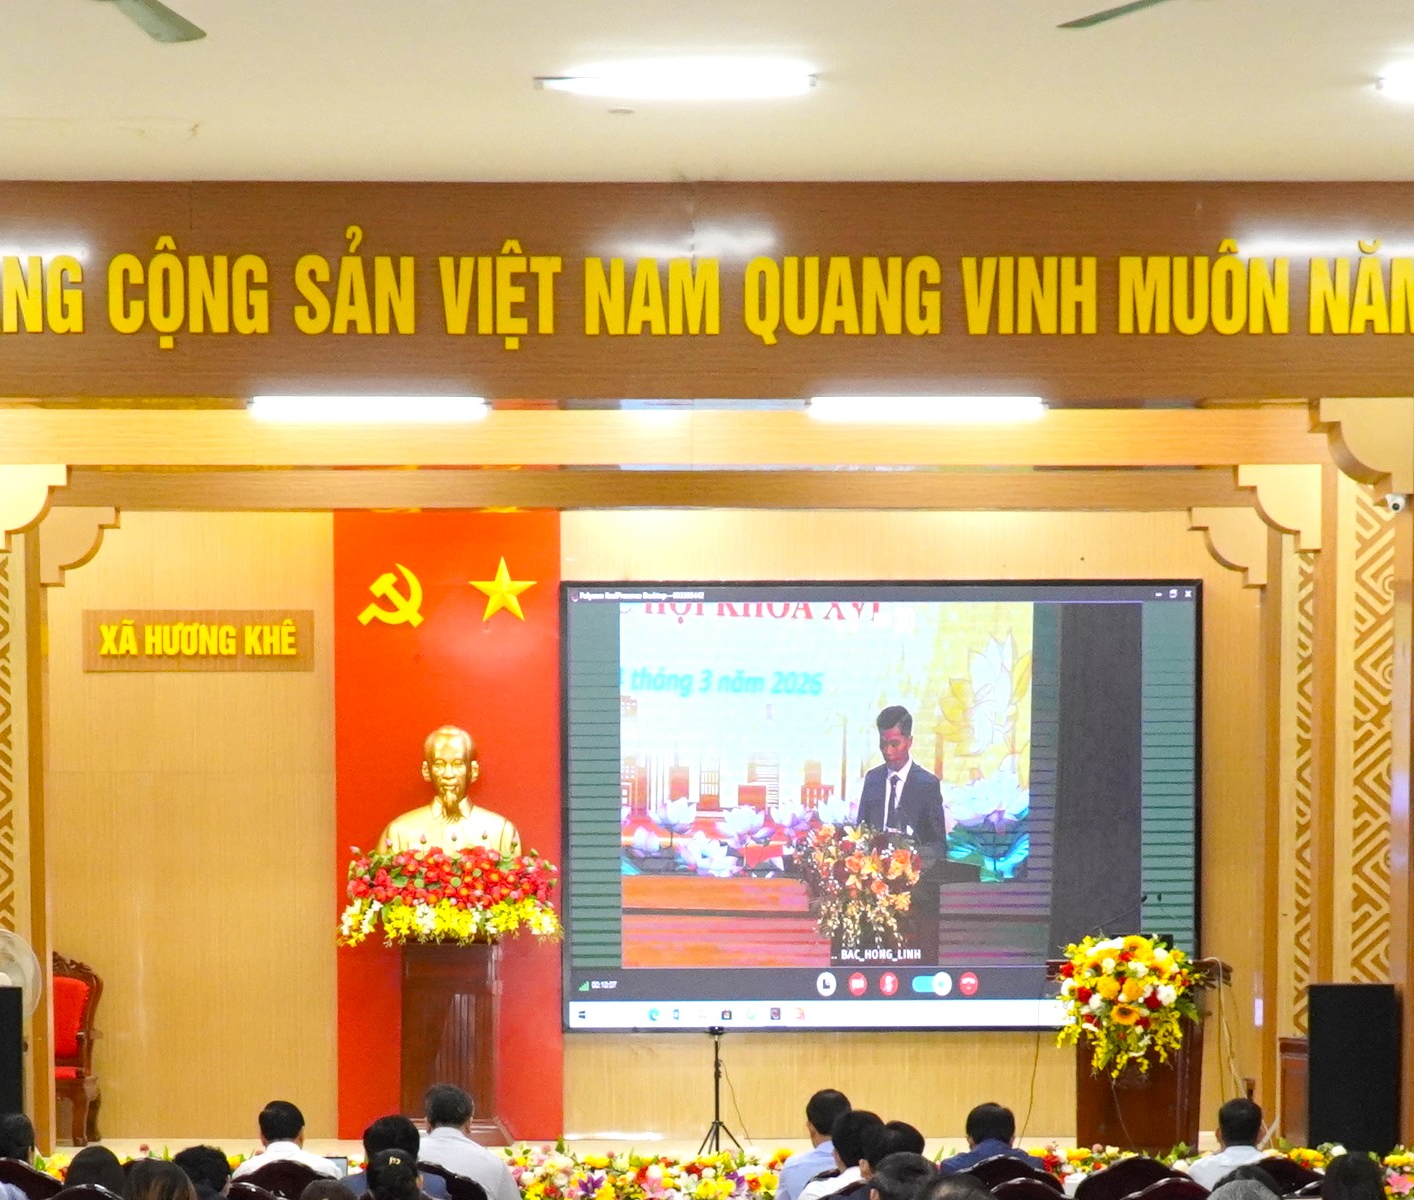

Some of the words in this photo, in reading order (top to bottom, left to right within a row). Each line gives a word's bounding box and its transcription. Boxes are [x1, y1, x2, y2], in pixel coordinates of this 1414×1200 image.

[108, 236, 269, 349] CỘNG
[293, 226, 415, 335] SẢN
[439, 239, 562, 349] VIỆT
[585, 257, 721, 335] NAM
[743, 256, 941, 345] QUANG
[961, 256, 1097, 335] VINH
[1118, 238, 1289, 335] MUÔN
[99, 619, 138, 656] XÃ
[144, 621, 237, 656] HƯƠNG
[244, 618, 297, 656] KHÊ
[631, 666, 693, 698] tháng
[698, 668, 713, 693] 3
[717, 669, 765, 694] năm
[770, 670, 825, 696] 2026
